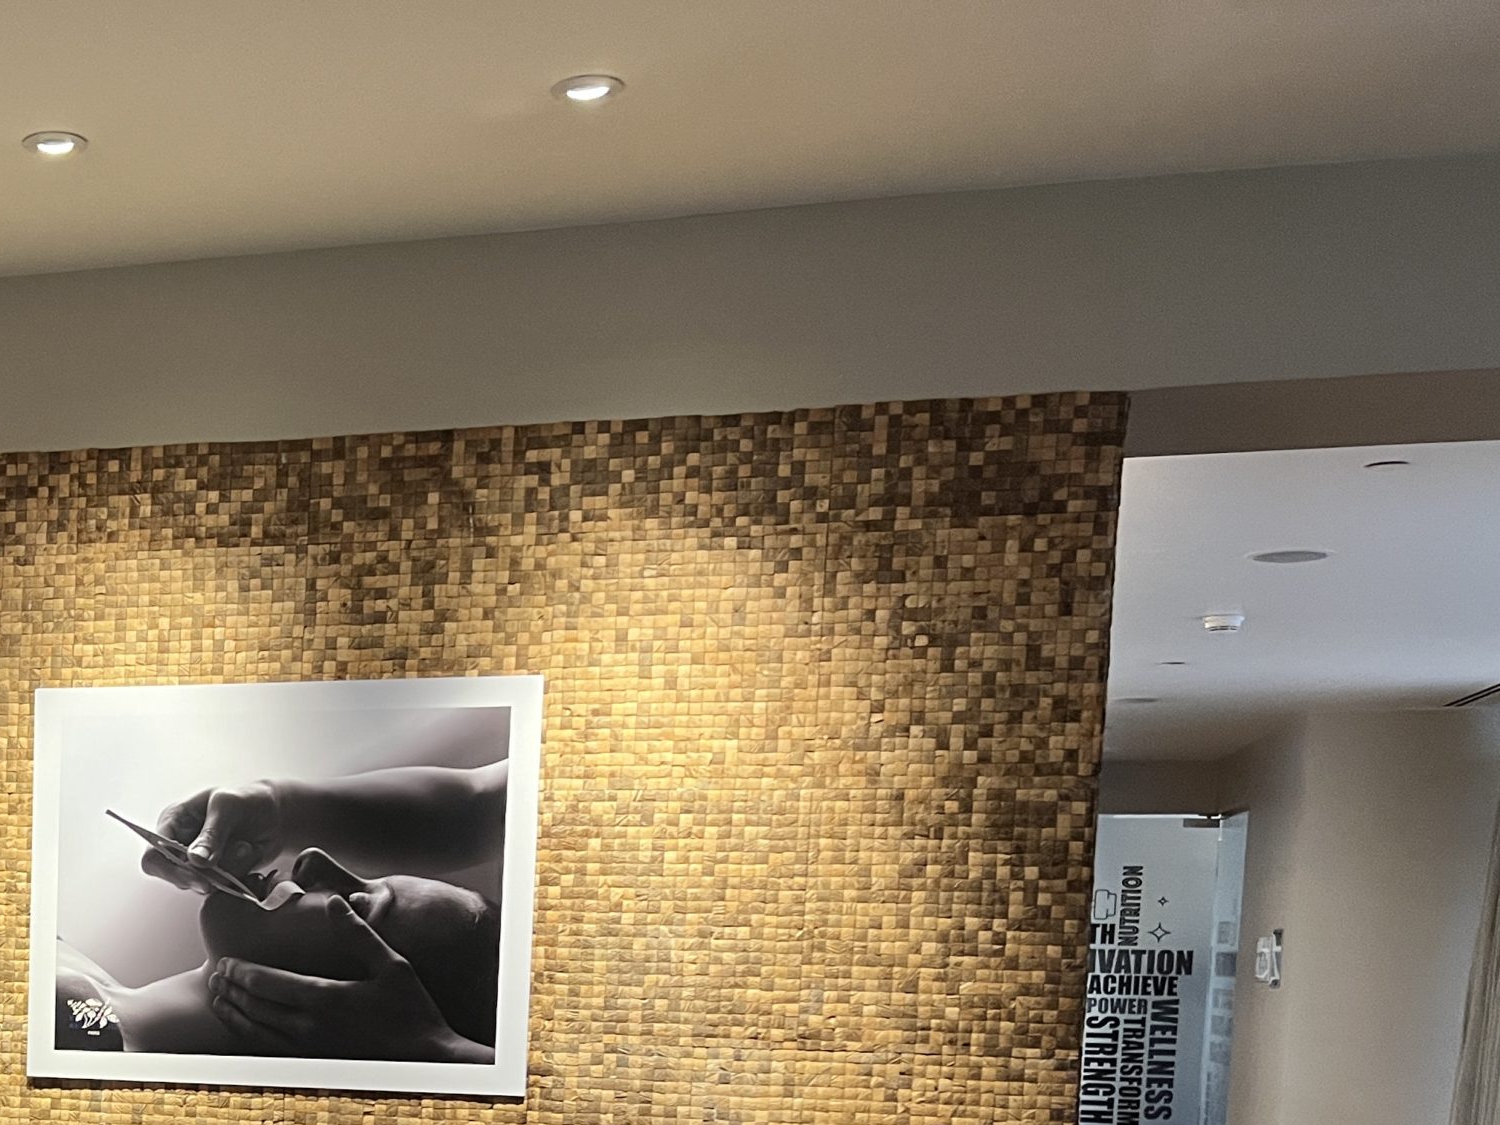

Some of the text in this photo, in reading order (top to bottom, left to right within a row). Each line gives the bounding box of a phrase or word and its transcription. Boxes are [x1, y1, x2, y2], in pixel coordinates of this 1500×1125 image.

[1118, 865, 1144, 947] NUTRITION
[1086, 997, 1149, 1015] POWER
[1088, 974, 1179, 997] ACHIEVE
[1079, 1016, 1121, 1125] STRENGTH
[1143, 999, 1180, 1121] WELLNESS
